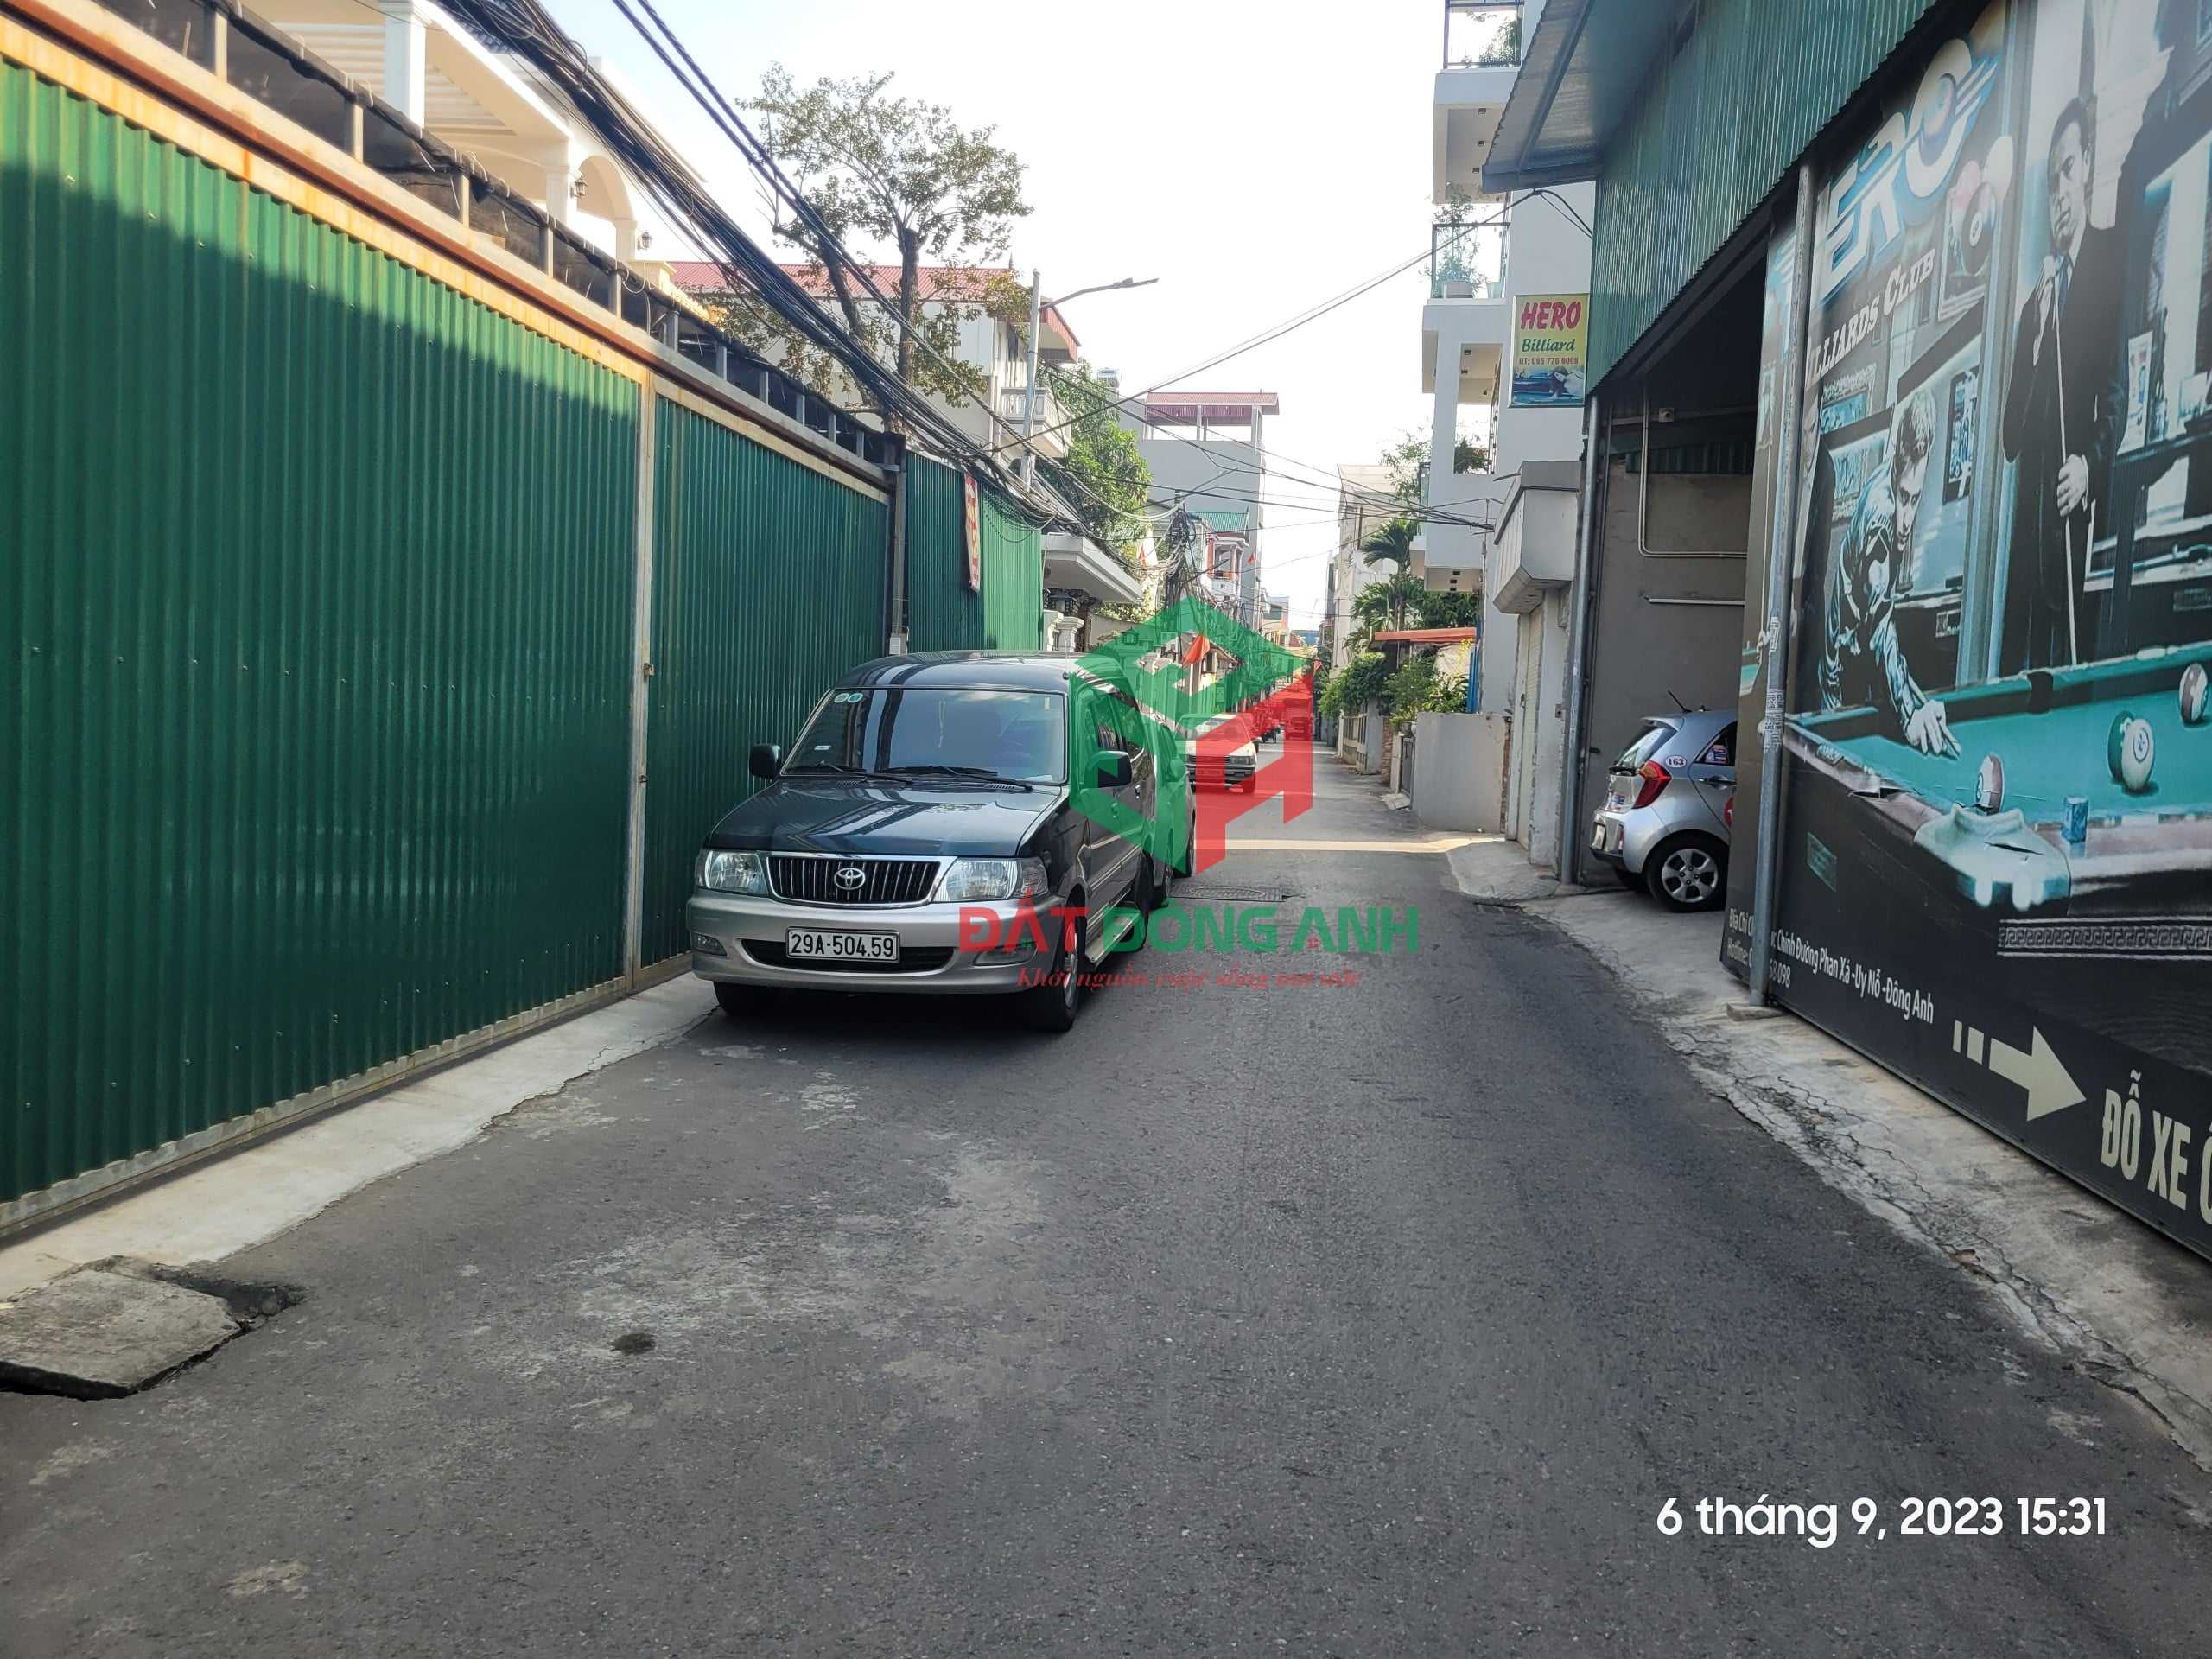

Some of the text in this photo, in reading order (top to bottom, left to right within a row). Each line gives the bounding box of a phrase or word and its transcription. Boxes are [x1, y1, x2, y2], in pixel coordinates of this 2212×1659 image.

[1813, 39, 1973, 302] ERO
[1521, 301, 1581, 331] HERO
[1521, 338, 1576, 353] Billiard
[791, 934, 894, 957] 29A-504.59
[1819, 947, 1839, 978] Phan
[1839, 957, 1851, 984] Xá
[1912, 989, 1934, 1024] Anh
[2101, 1069, 2141, 1181] ĐỖ
[2147, 1110, 2191, 1210] XE
